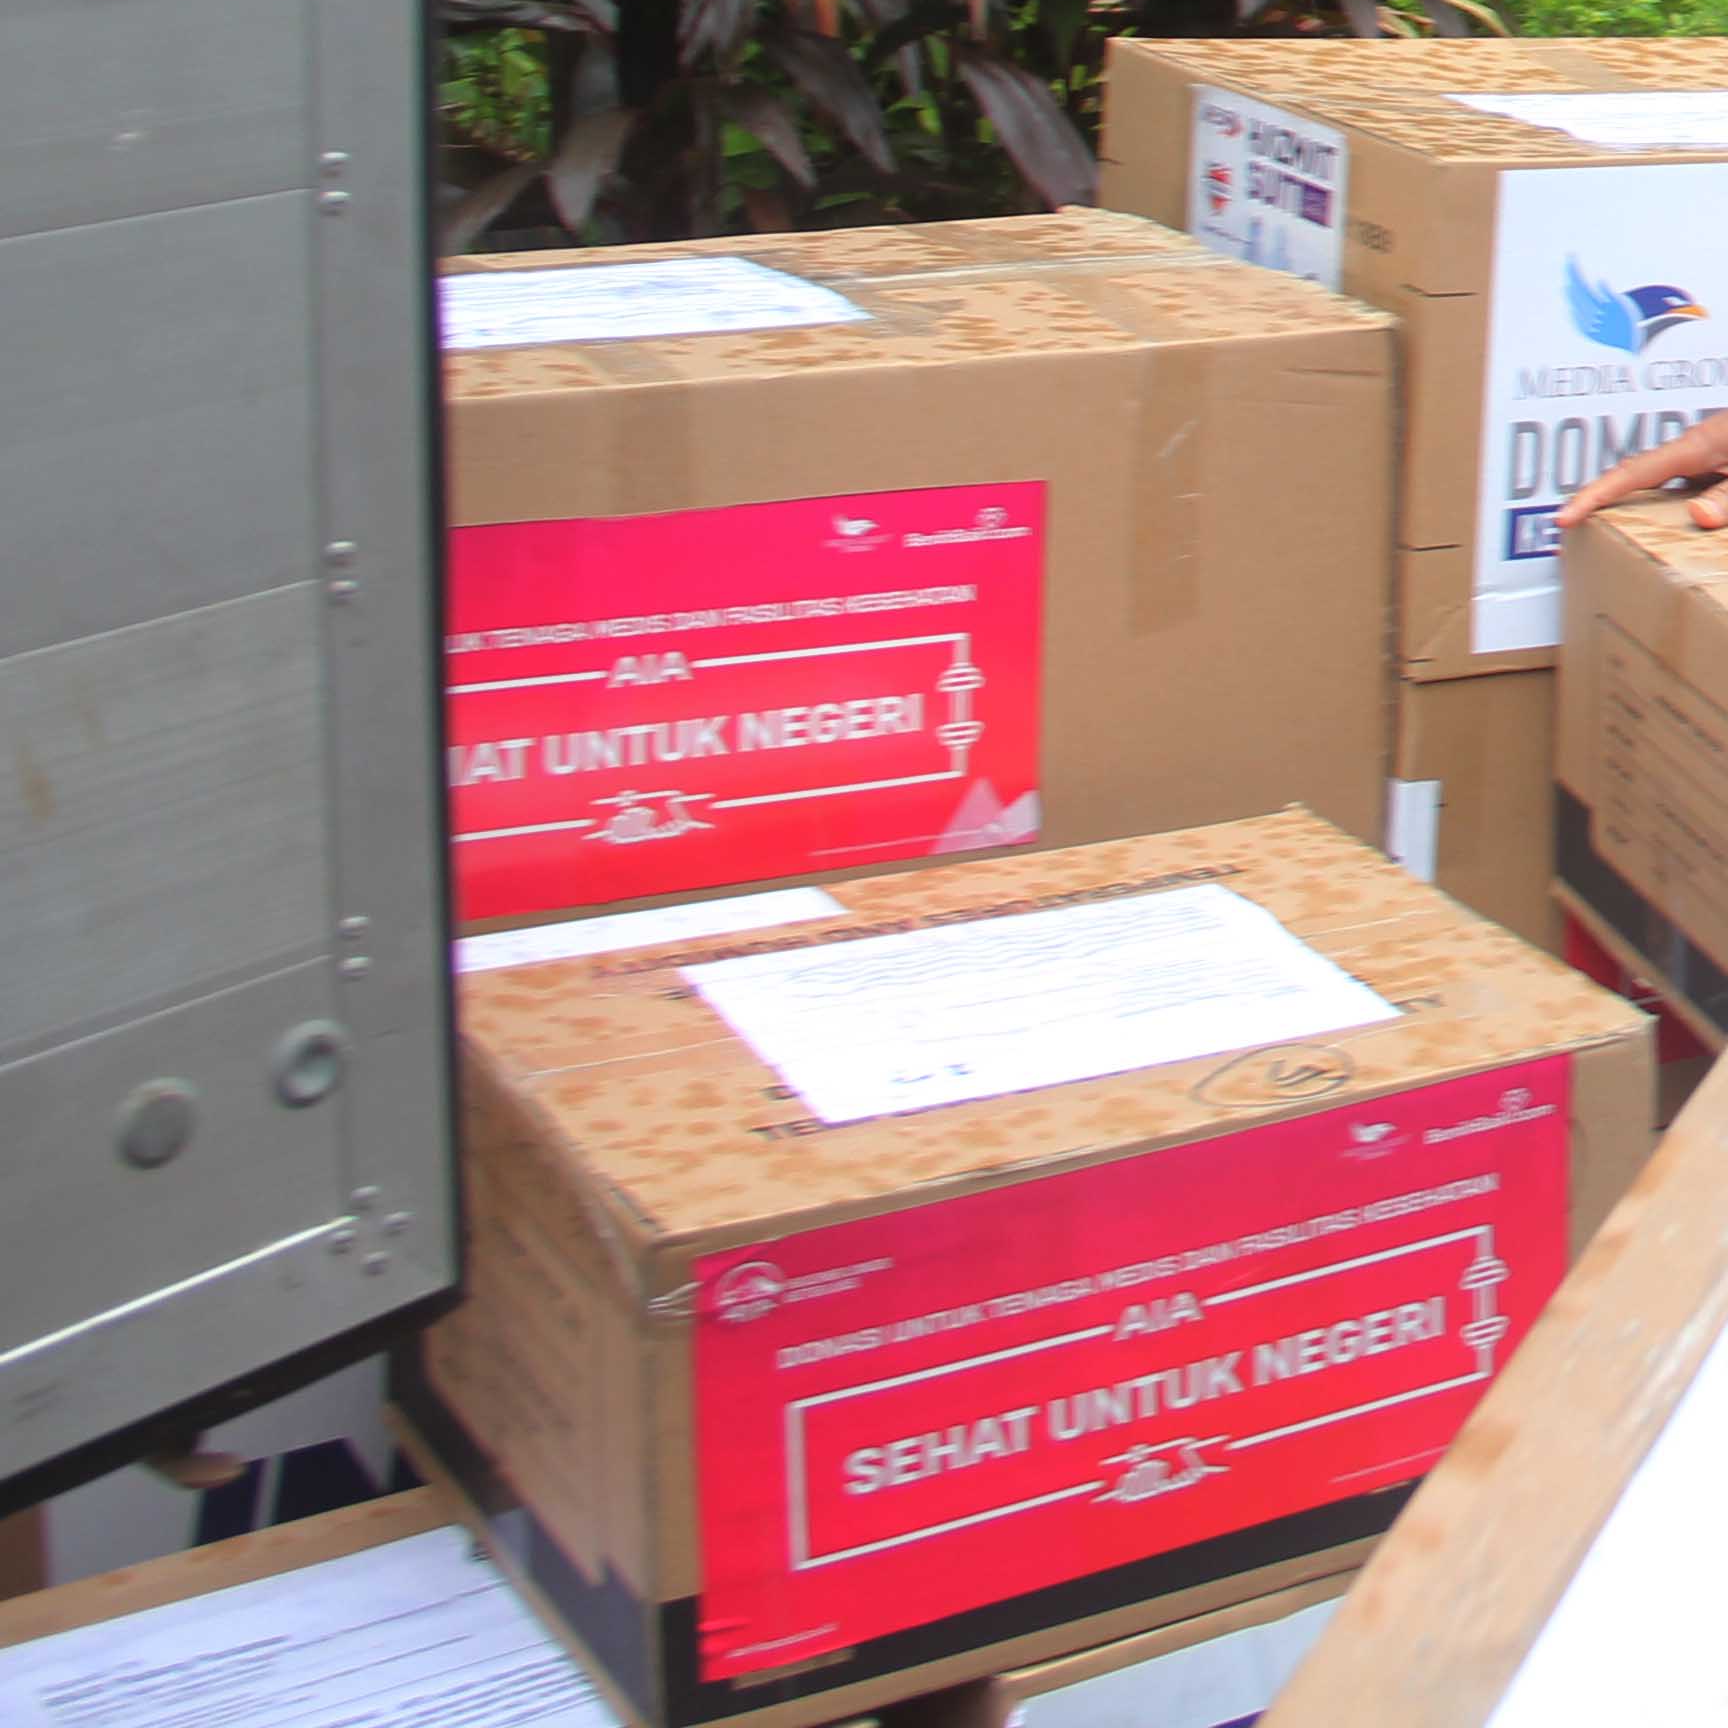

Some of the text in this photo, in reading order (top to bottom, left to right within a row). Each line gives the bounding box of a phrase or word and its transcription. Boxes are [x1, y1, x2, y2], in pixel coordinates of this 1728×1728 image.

[1511, 364, 1638, 401] MEDIA
[606, 650, 695, 689] AIA
[543, 715, 732, 774] UNTUK
[735, 693, 926, 753] NEGERI
[776, 1172, 1500, 1370] DONASI UNTUK TENAGA MEDIS DAN FASILITAS KESEHATAN
[1111, 1291, 1206, 1342] AIA
[843, 1295, 1448, 1496] SEHAT UNTUK NEGERI
